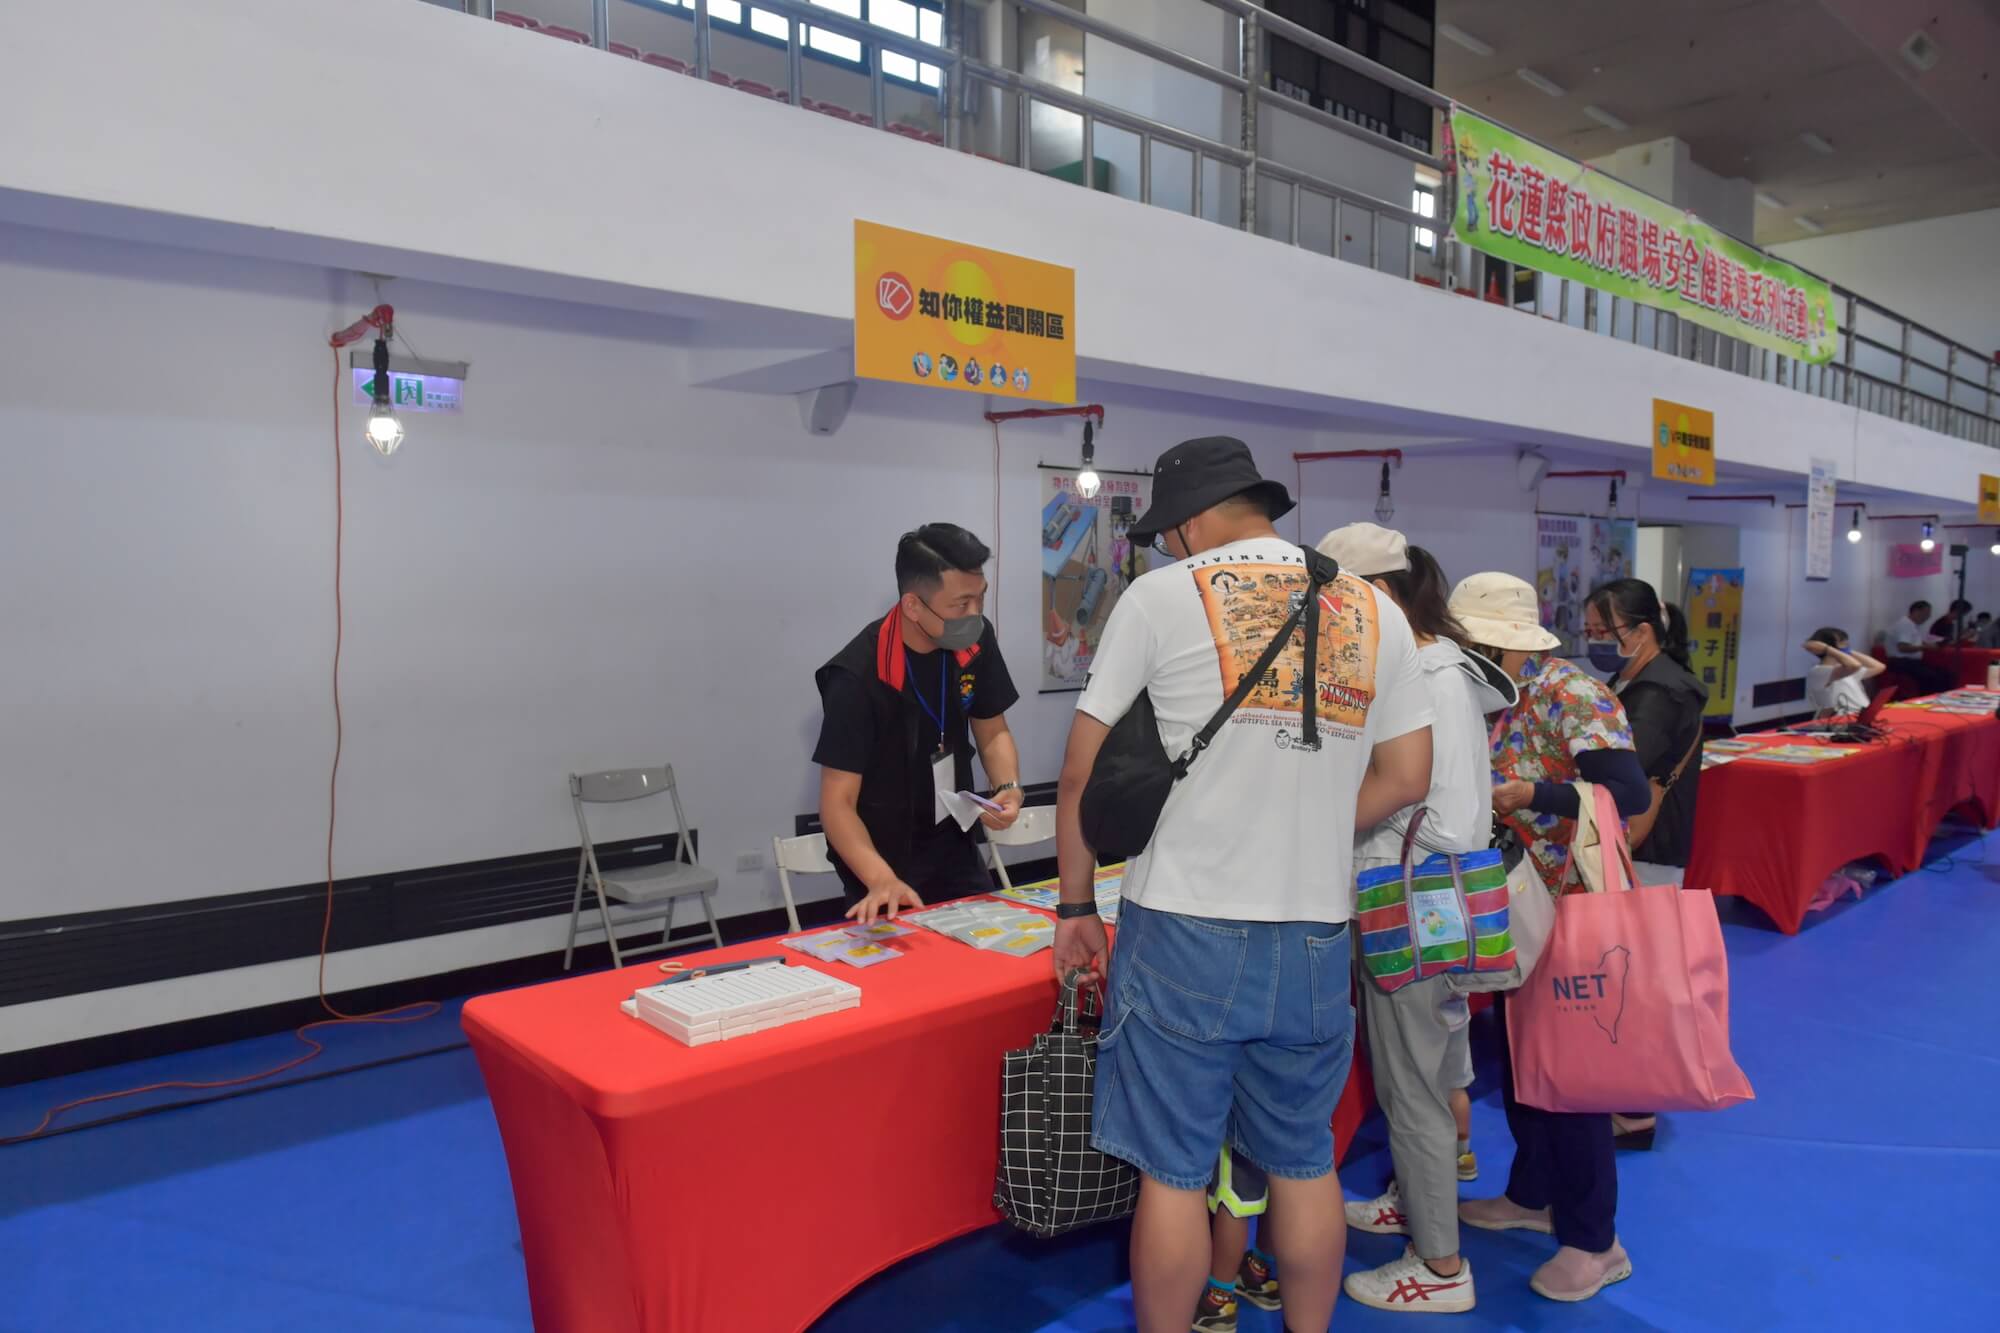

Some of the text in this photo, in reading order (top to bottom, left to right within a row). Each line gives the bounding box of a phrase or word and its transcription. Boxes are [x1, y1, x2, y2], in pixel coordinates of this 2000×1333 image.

[918, 287, 1065, 340] 知你權益闖關區
[1186, 554, 1305, 569] DIVING PA
[1552, 974, 1607, 1000] NET
